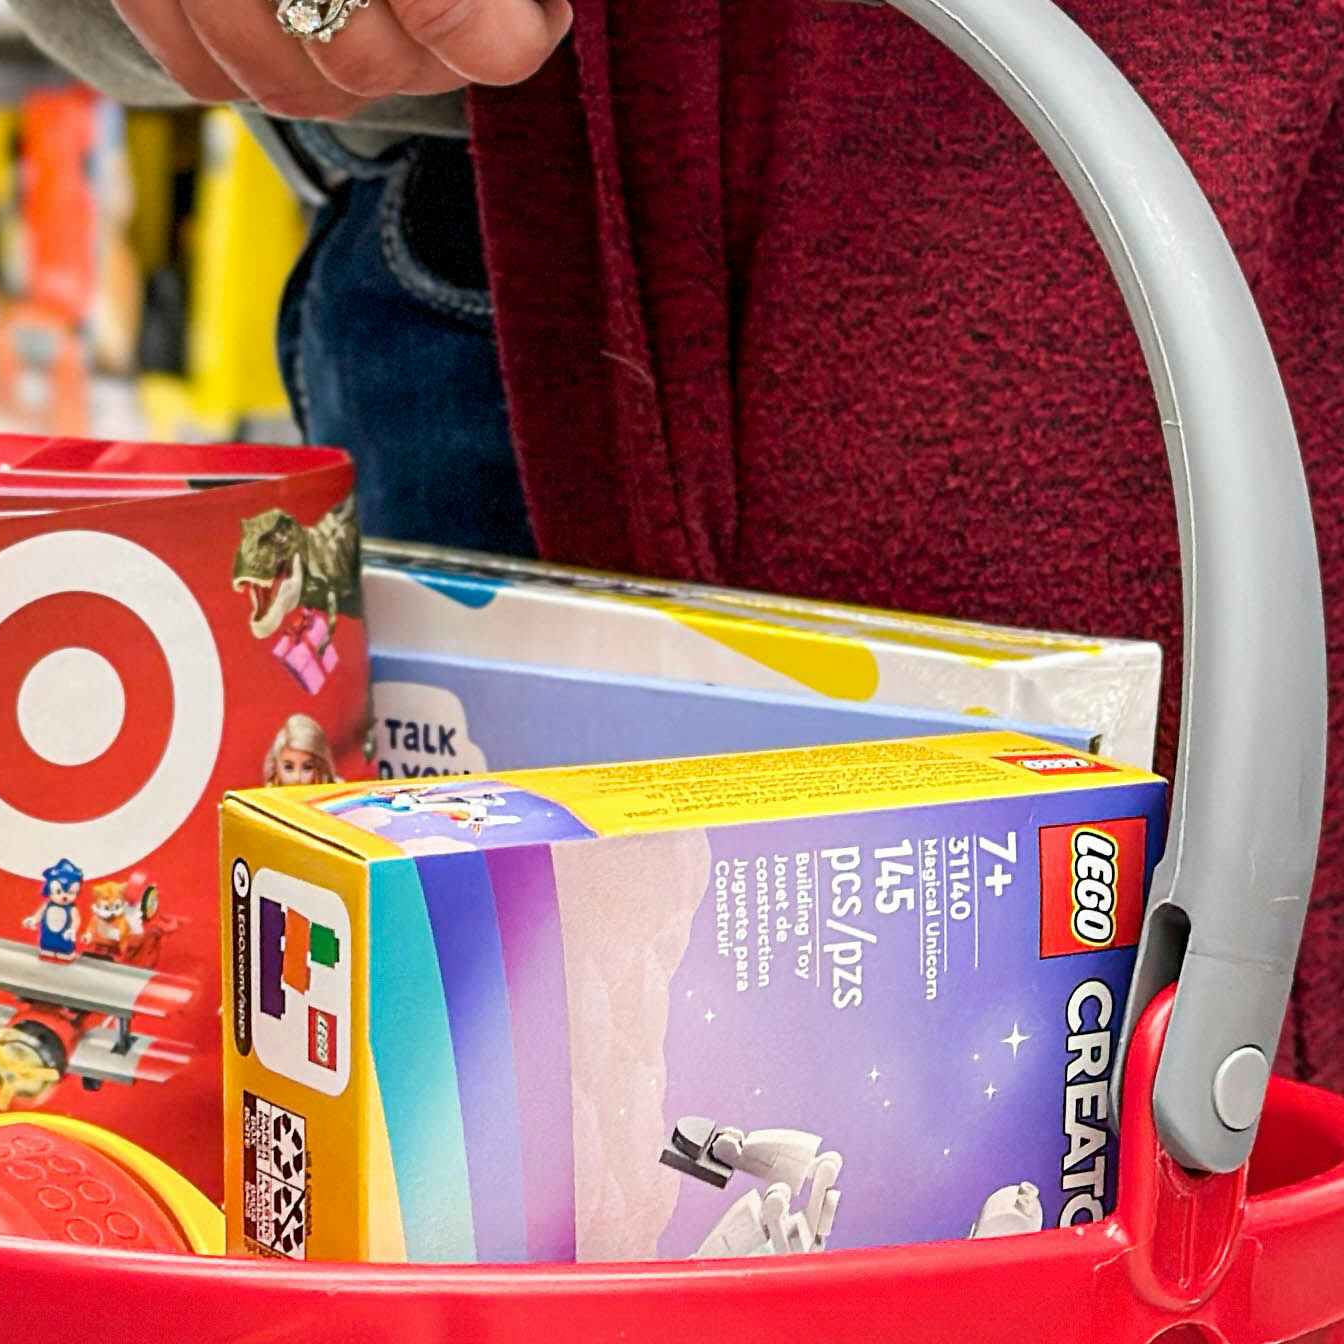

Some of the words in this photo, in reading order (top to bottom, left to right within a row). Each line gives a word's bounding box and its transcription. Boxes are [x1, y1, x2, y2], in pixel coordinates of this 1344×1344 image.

[731, 858, 749, 941] Juguete
[773, 854, 790, 912] Jouet
[794, 852, 813, 937] Building
[873, 838, 915, 914] 145
[922, 838, 942, 917] Magical
[948, 836, 971, 921] 31140
[979, 832, 1017, 896] 7+
[1073, 829, 1117, 945] LEGO
[714, 860, 734, 957] Construir
[756, 856, 774, 988] construction
[775, 916, 792, 943] de
[820, 846, 878, 1010] pcs/pzs
[733, 945, 749, 992] para
[794, 939, 813, 979] Toy
[924, 921, 942, 1001] Unicorn
